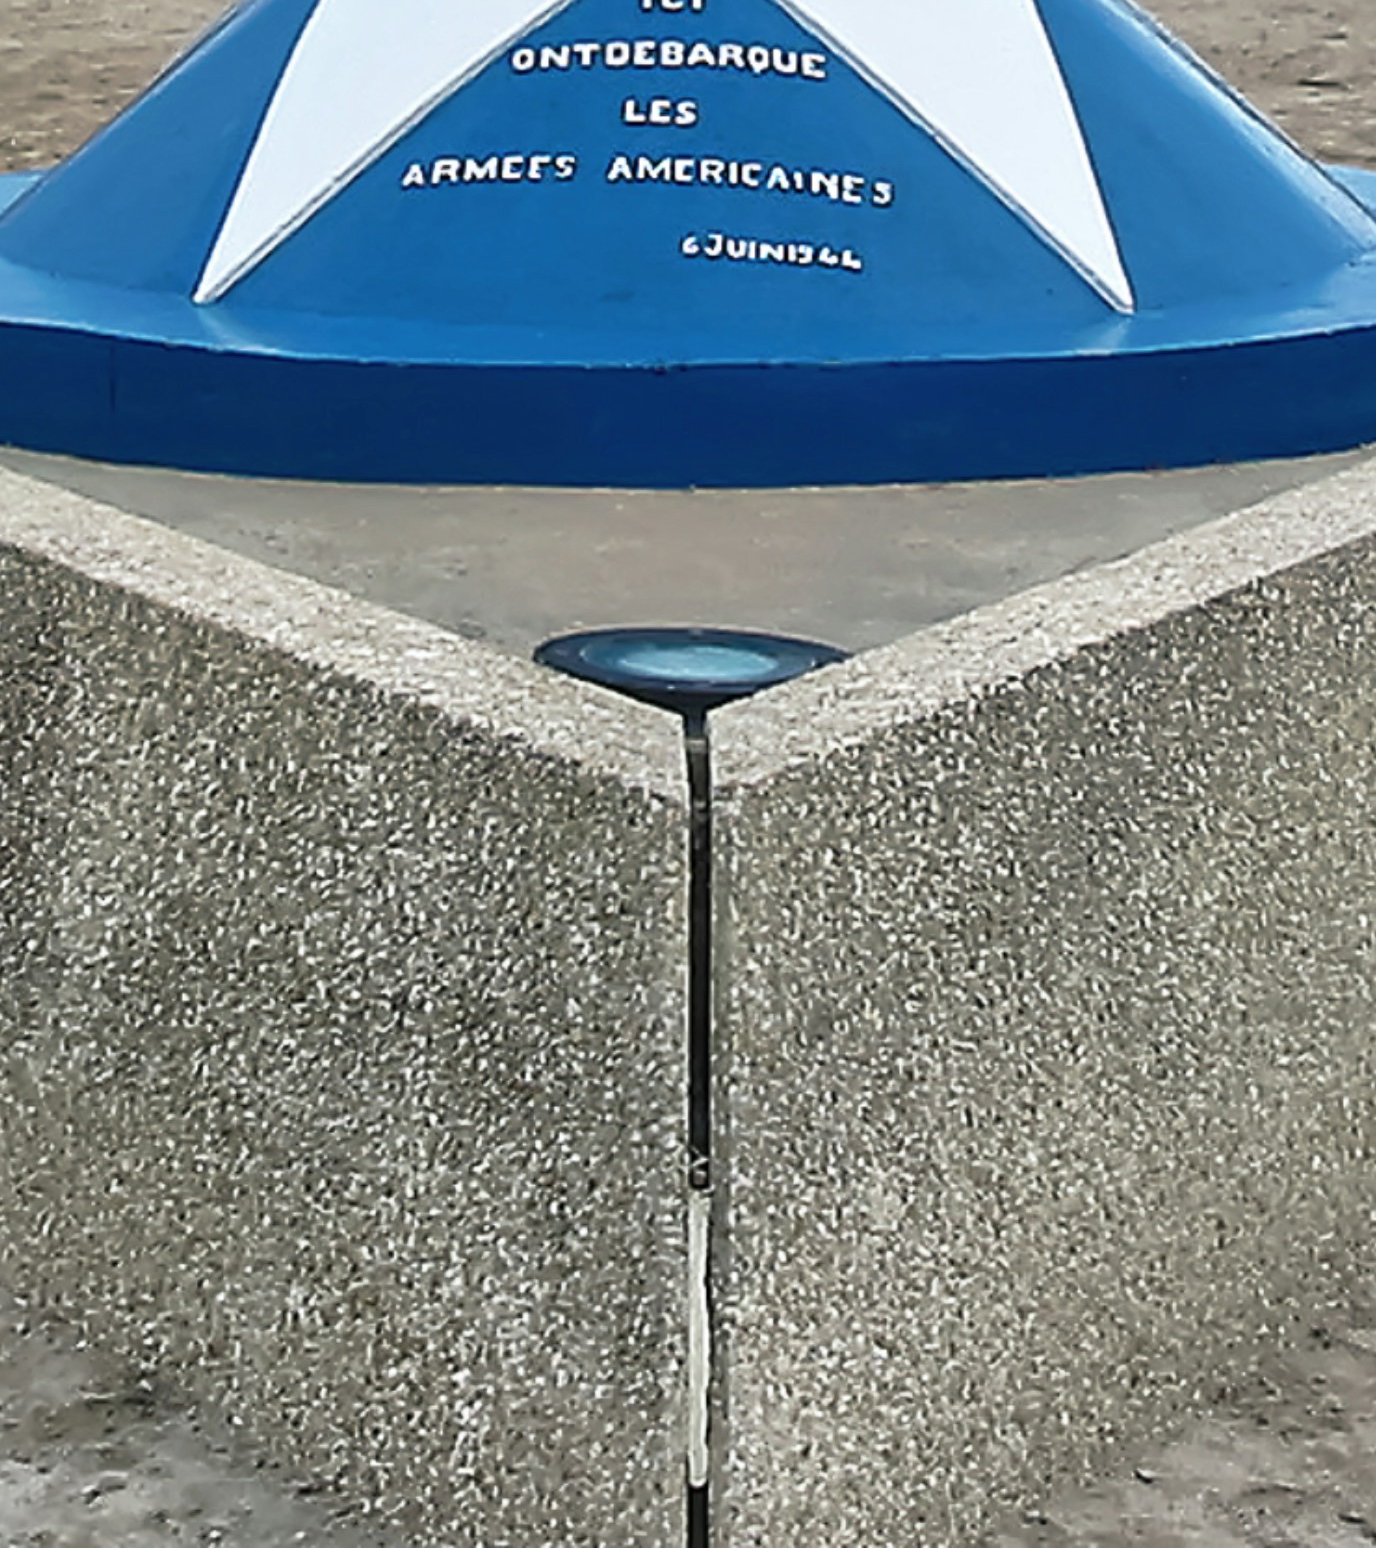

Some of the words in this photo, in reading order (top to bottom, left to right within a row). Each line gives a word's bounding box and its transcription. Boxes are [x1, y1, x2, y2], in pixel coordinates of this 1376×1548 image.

[624, 99, 699, 126] LES
[401, 155, 577, 188] ARMEES
[606, 155, 894, 206] AMERICAINES
